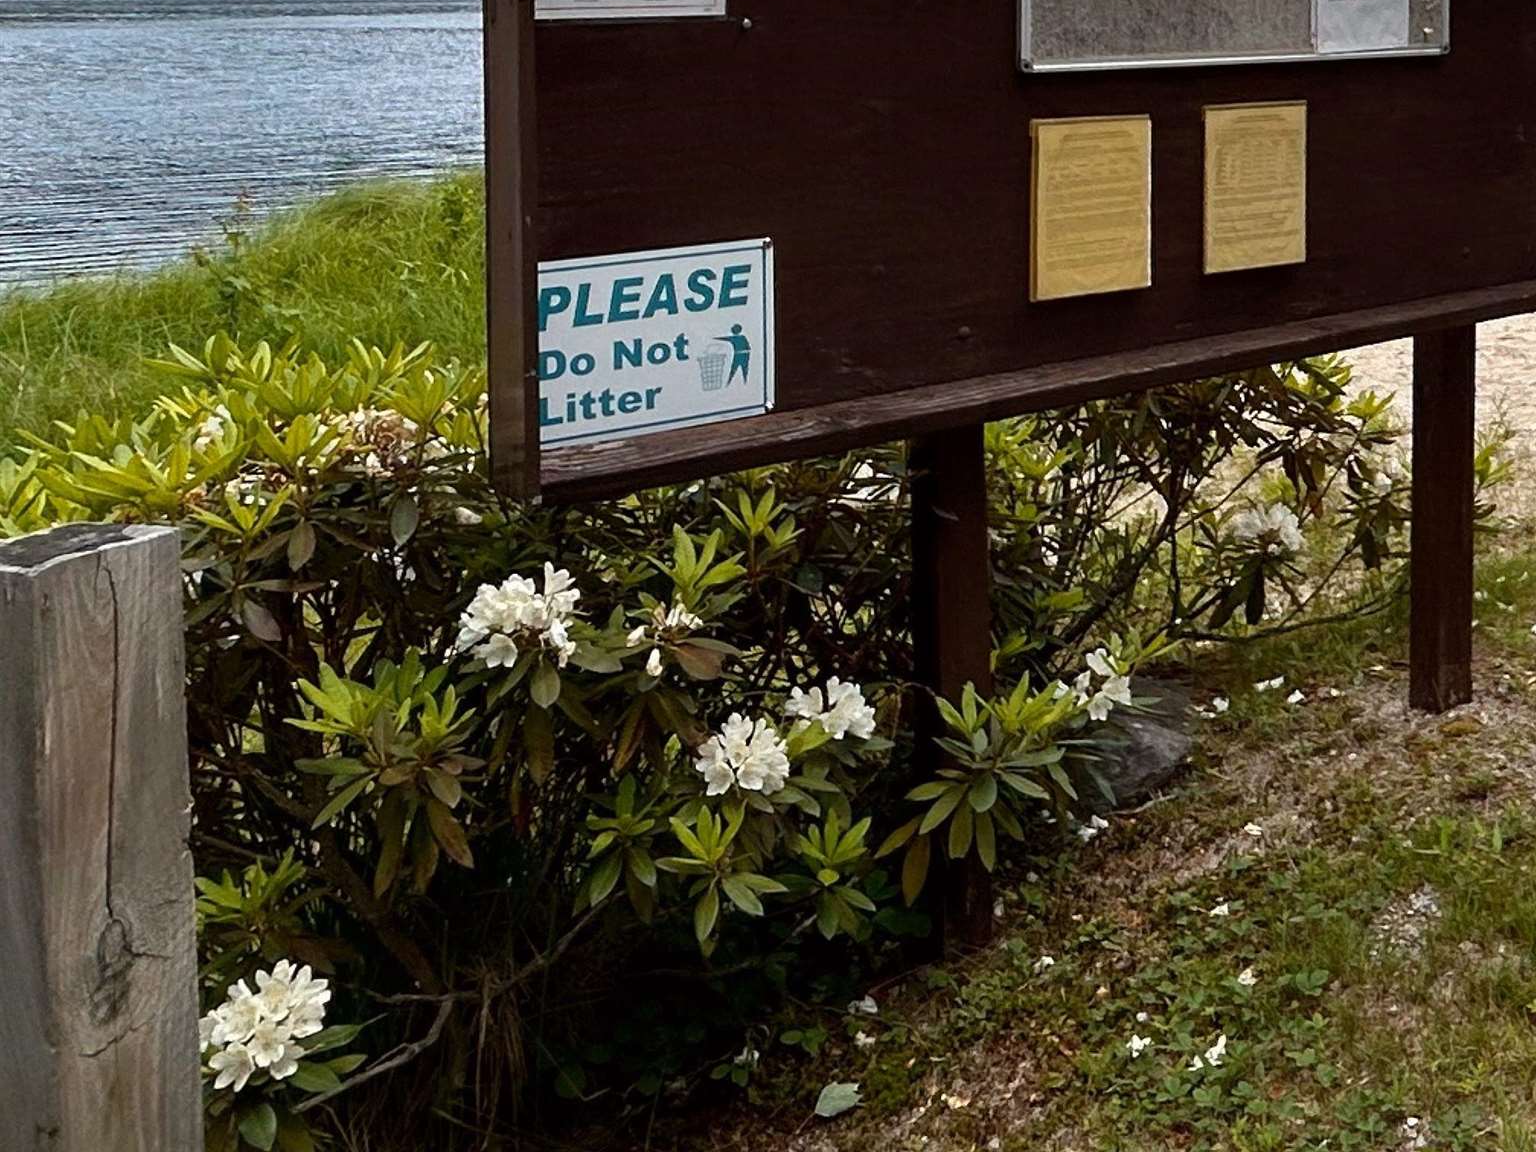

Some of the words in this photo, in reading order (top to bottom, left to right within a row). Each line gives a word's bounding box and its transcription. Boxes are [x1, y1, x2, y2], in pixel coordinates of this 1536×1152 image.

[538, 264, 752, 332] PLEASE
[538, 350, 596, 381] Do
[613, 332, 690, 371] Not
[539, 386, 663, 427] Litter
